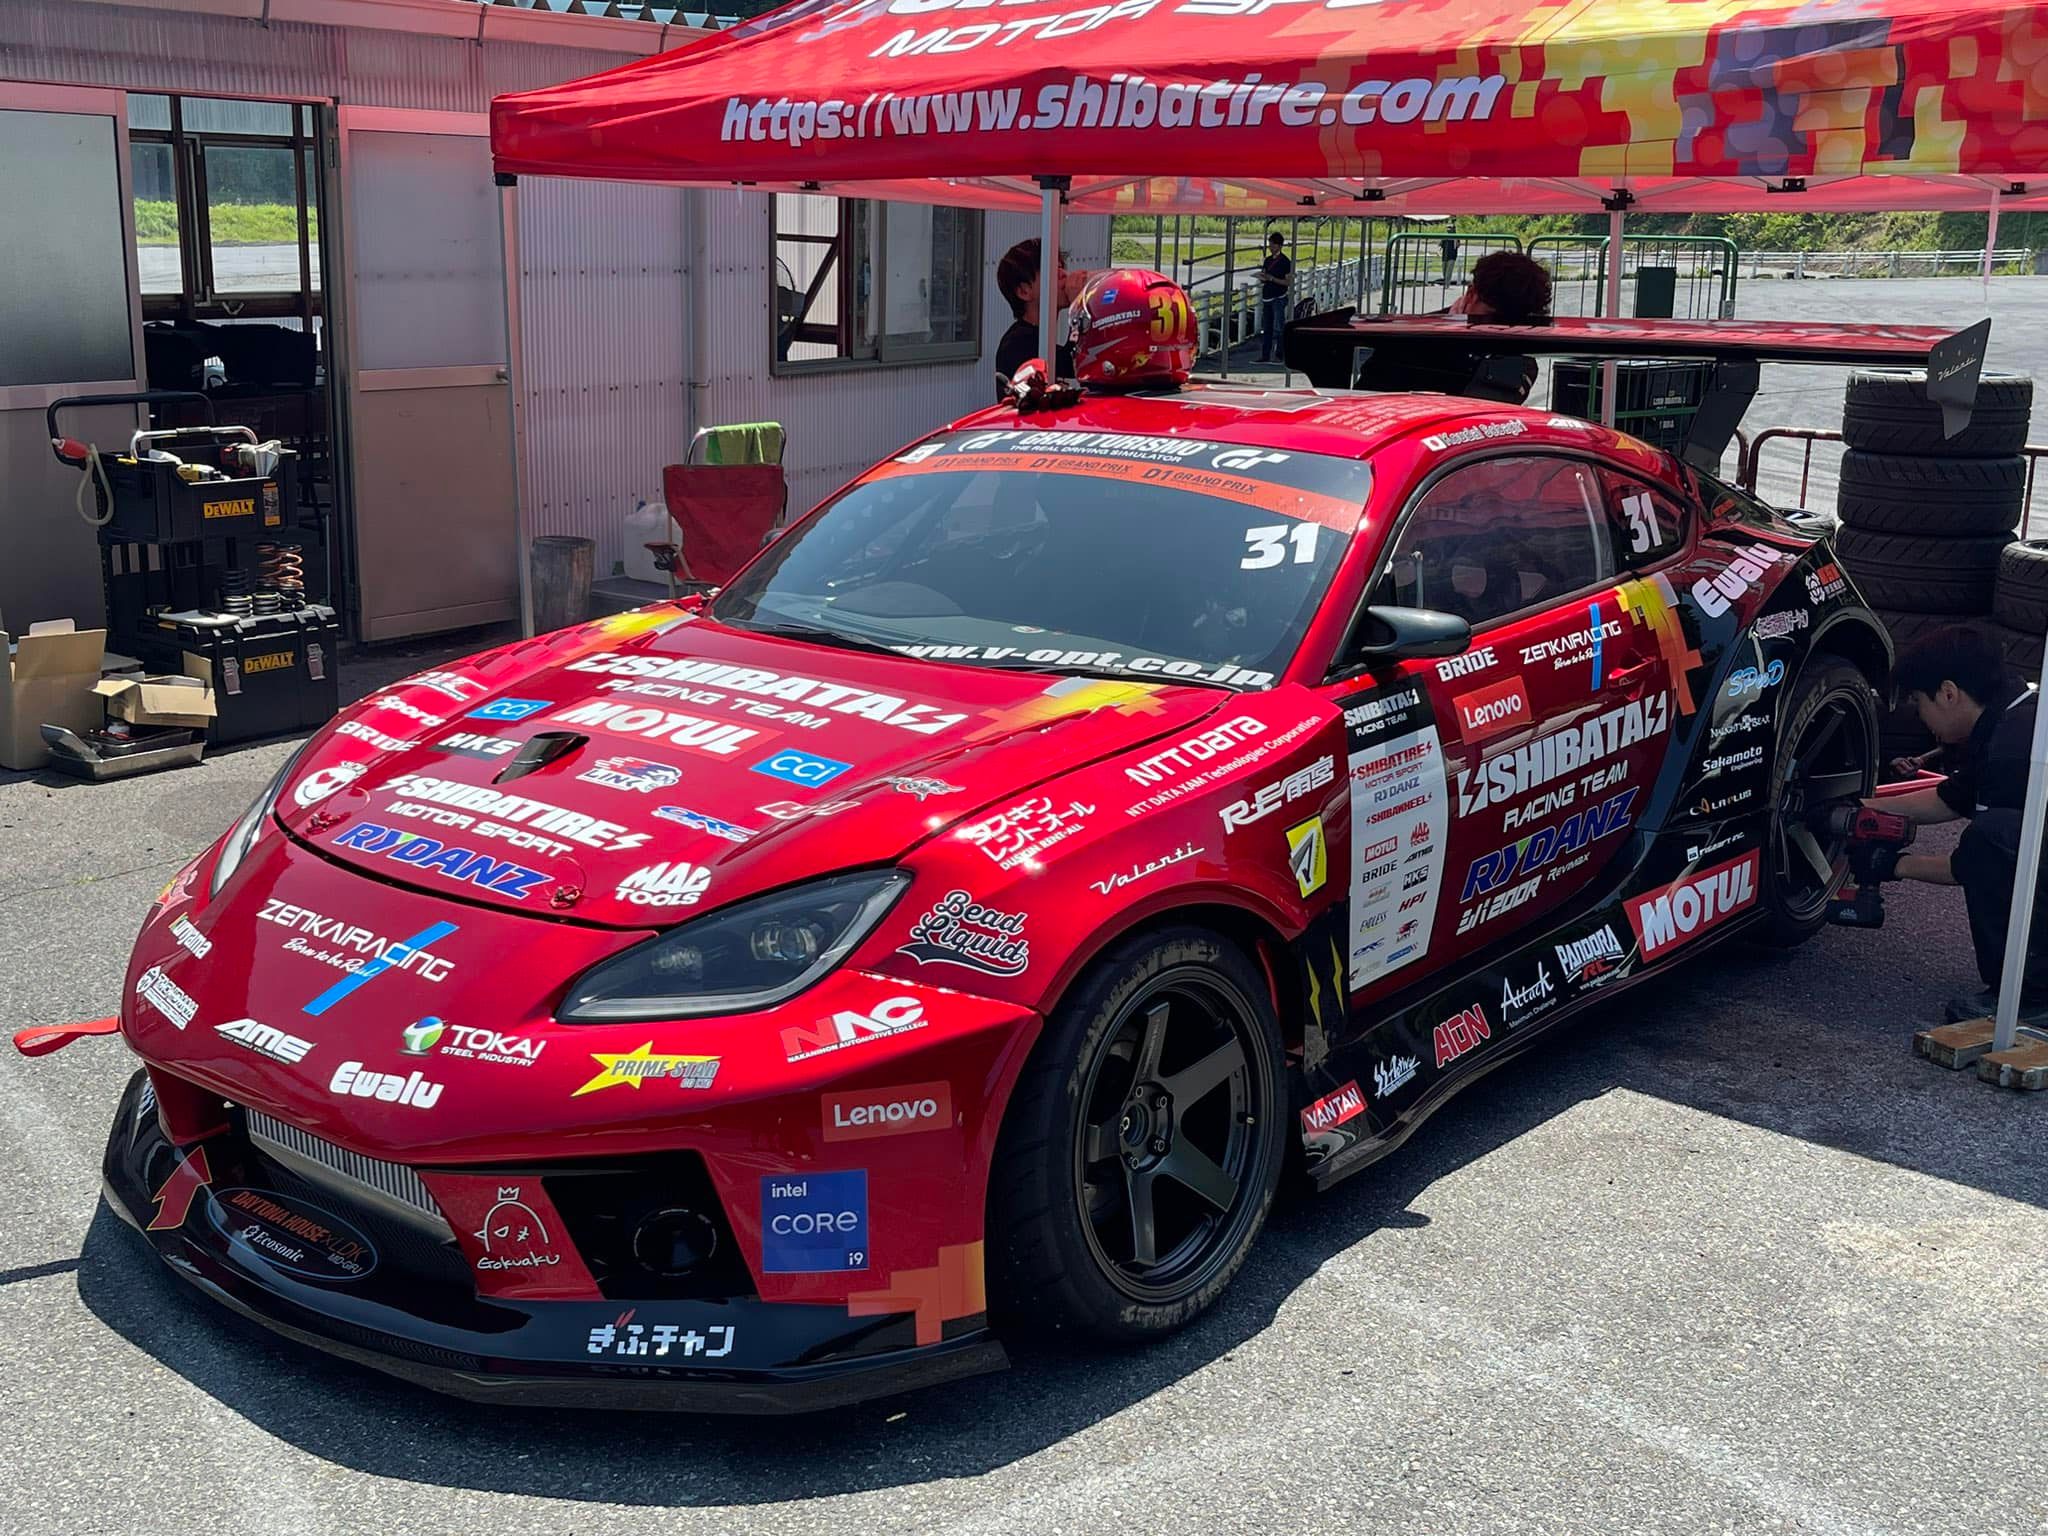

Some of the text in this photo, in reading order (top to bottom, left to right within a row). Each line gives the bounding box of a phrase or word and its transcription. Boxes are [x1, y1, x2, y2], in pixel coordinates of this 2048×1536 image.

[720, 73, 1506, 147] https://www.shibatire.com
[1148, 291, 1188, 343] 31
[1019, 431, 1208, 456] GRAN TURISMO
[1173, 472, 1222, 486] GRAND
[1222, 478, 1259, 493] PRIX
[1621, 492, 1664, 554] 31
[1240, 522, 1321, 570] 31
[1691, 542, 1782, 618] Ewalu
[1435, 646, 1499, 682] BRIDE
[597, 679, 831, 730] RACING TEAM
[608, 655, 913, 723] SHIBATA
[1343, 690, 1410, 727] SHIBATA
[552, 702, 760, 756] MOTUL
[1355, 712, 1408, 737] RACING TEAM
[1464, 694, 1522, 730] Lenovo
[335, 721, 421, 751] BRIDE
[438, 732, 522, 755] HKS
[1488, 699, 1650, 803] SHIBATA
[1124, 747, 1193, 787] NTT
[1125, 715, 1322, 817] NTT DATA XAM Technologies Corporation
[1702, 746, 1763, 772] Sakamoto
[395, 775, 630, 849] SHIBATIRE
[1374, 776, 1421, 803] RYDANZ
[1502, 759, 1629, 833] RACING TEAM
[384, 801, 574, 858] MOTOR SPORT
[981, 801, 1096, 862] レントオール
[1459, 785, 1641, 904] RYDANZ
[331, 821, 555, 899] RYDANZ
[622, 861, 712, 892] MAC
[1089, 842, 1206, 896] Valenti
[1362, 860, 1398, 884] BRIDE
[614, 886, 701, 907] TOOLS
[933, 889, 1028, 936] Bead
[1638, 859, 1756, 954] MOTUL
[909, 911, 1029, 964] Liquid
[1554, 923, 1624, 976] PANDORA
[1500, 960, 1554, 1022] Attack
[213, 1018, 316, 1063] AME
[450, 1024, 546, 1059] TOKAI
[780, 996, 924, 1057] NAC
[839, 1029, 893, 1049] AUTOMOTIVE
[893, 1020, 929, 1035] COLLEGE
[440, 1046, 535, 1066] STEEL INDUSTRY
[610, 1060, 721, 1079] PRIME STAR
[329, 1061, 445, 1110] Ewalu
[1306, 1087, 1362, 1129] VANTAN
[833, 1097, 937, 1128] Lenovo
[231, 1190, 286, 1224] DAYTONA
[771, 1181, 807, 1198] intel
[253, 1231, 305, 1264] Ecosonic
[848, 1250, 864, 1267] i9
